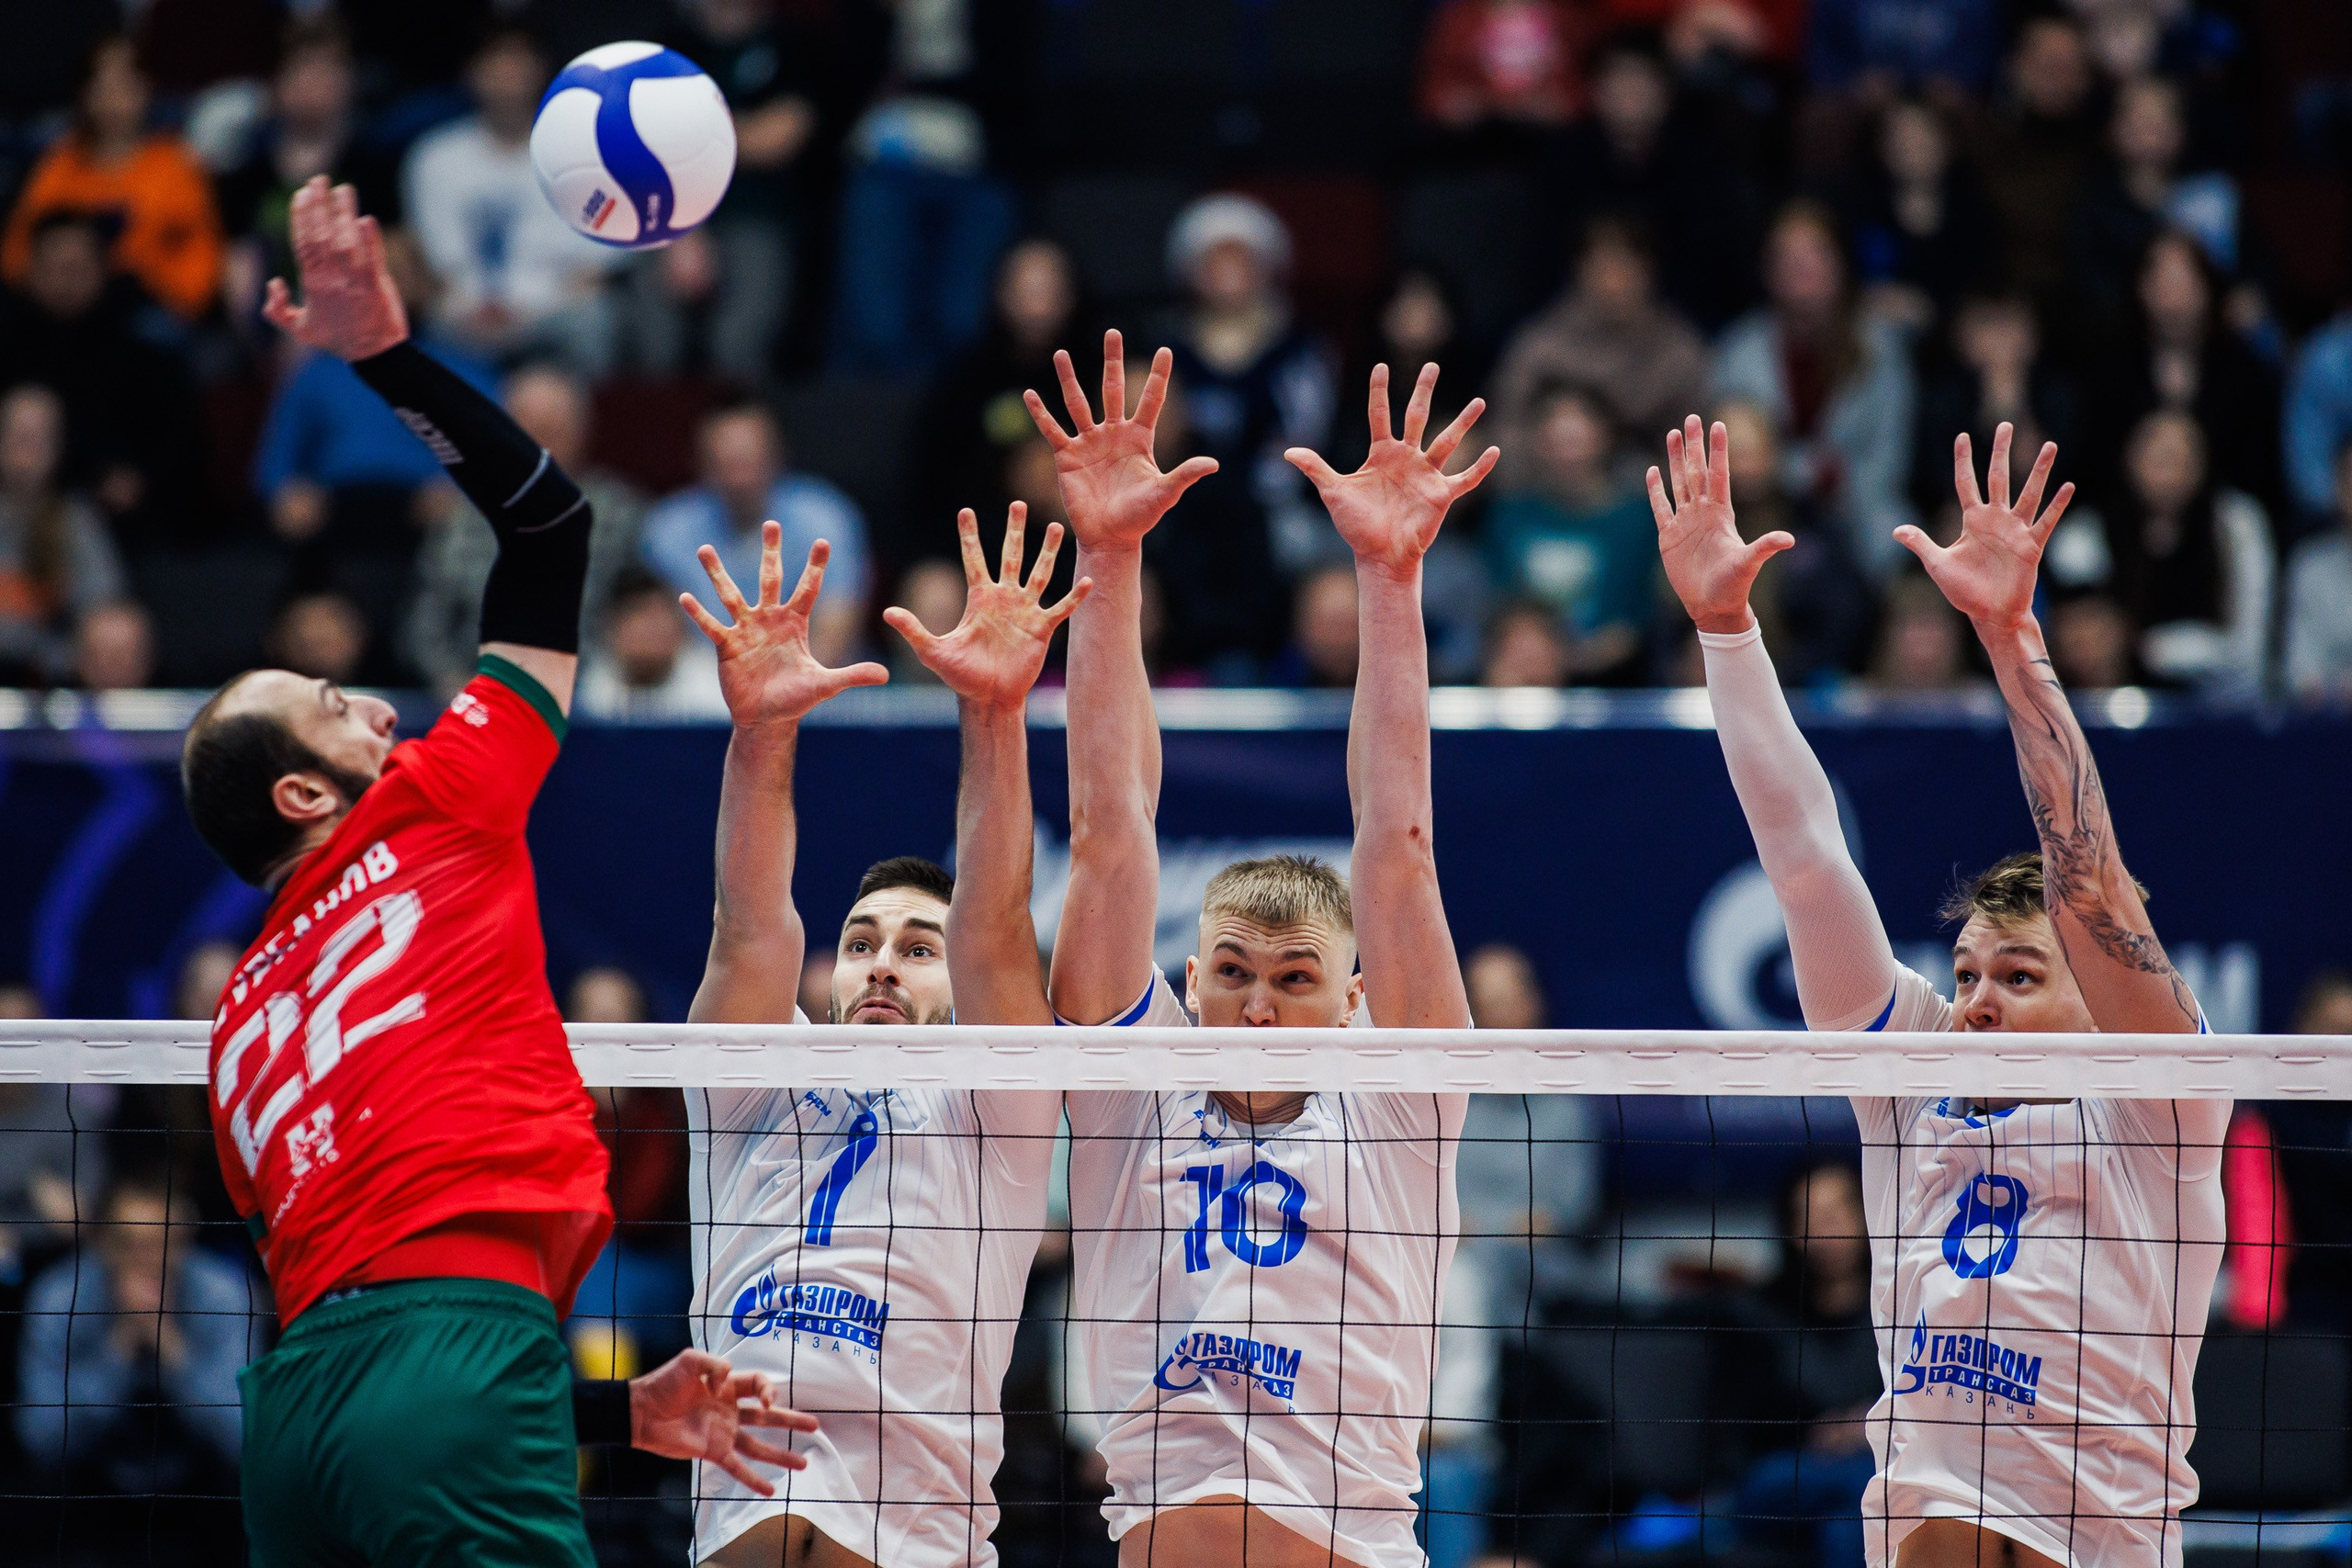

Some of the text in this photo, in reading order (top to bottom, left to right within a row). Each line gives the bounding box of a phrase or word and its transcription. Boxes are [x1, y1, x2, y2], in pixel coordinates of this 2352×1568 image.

[215, 887, 427, 1179] 22
[1179, 1159, 1308, 1274] 10
[1940, 1170, 2030, 1280] 8
[779, 1284, 890, 1332] ГАЗПРОМ
[773, 1328, 877, 1365] КАЗАНЬ
[1192, 1332, 1302, 1379] ГАЗПРОМ
[1929, 1333, 2042, 1388] ГАЗПРОМ
[1925, 1384, 2036, 1420] КАЗАНЬ
[1932, 1367, 2033, 1403] ТРАНСГАЗ
